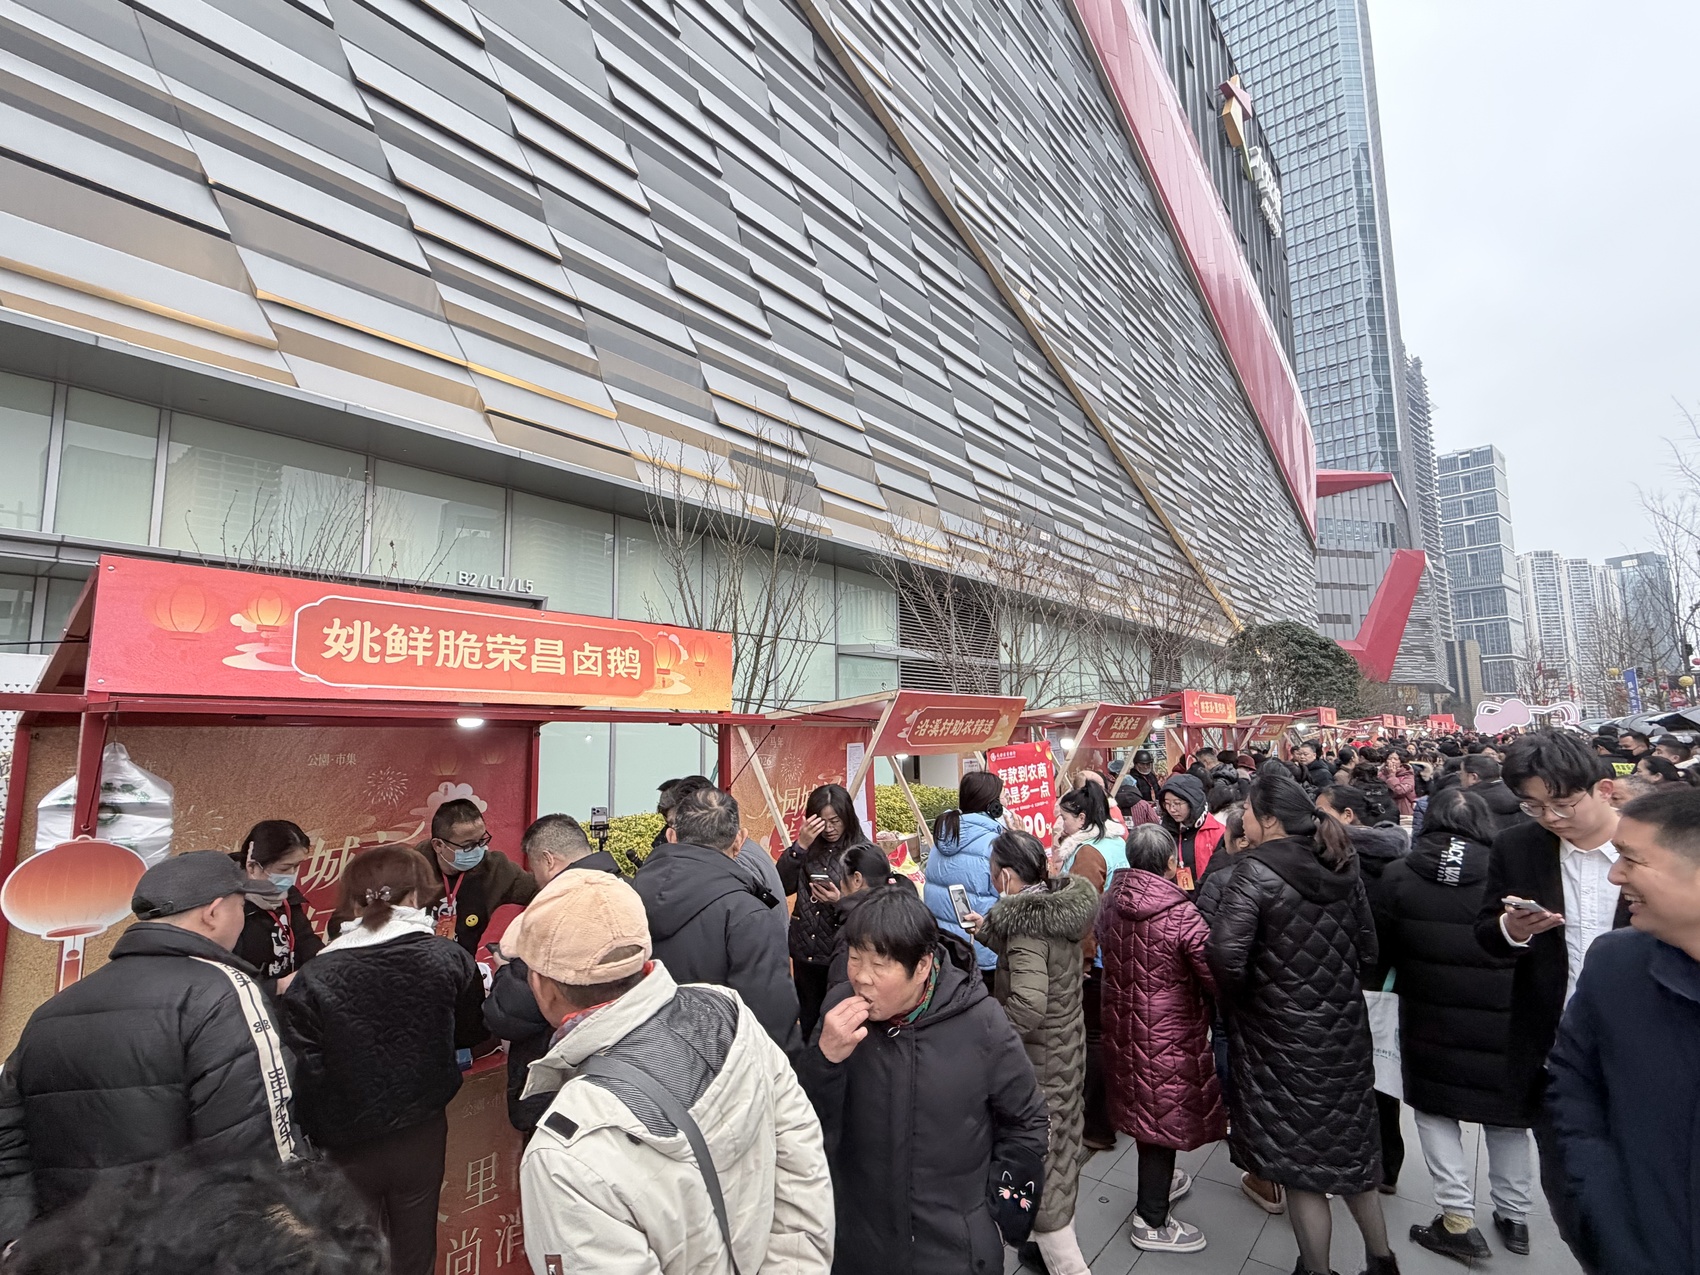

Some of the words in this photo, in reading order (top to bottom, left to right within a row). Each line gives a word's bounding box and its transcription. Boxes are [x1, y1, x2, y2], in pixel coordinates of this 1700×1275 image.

[456, 570, 535, 593] B2/L1/L5
[320, 616, 642, 681] 姚鲜脆荣昌卤鹅
[914, 718, 995, 738] 沿溪村助农精选
[997, 761, 1048, 787] 存款到农商
[1447, 836, 1466, 865] JACK
